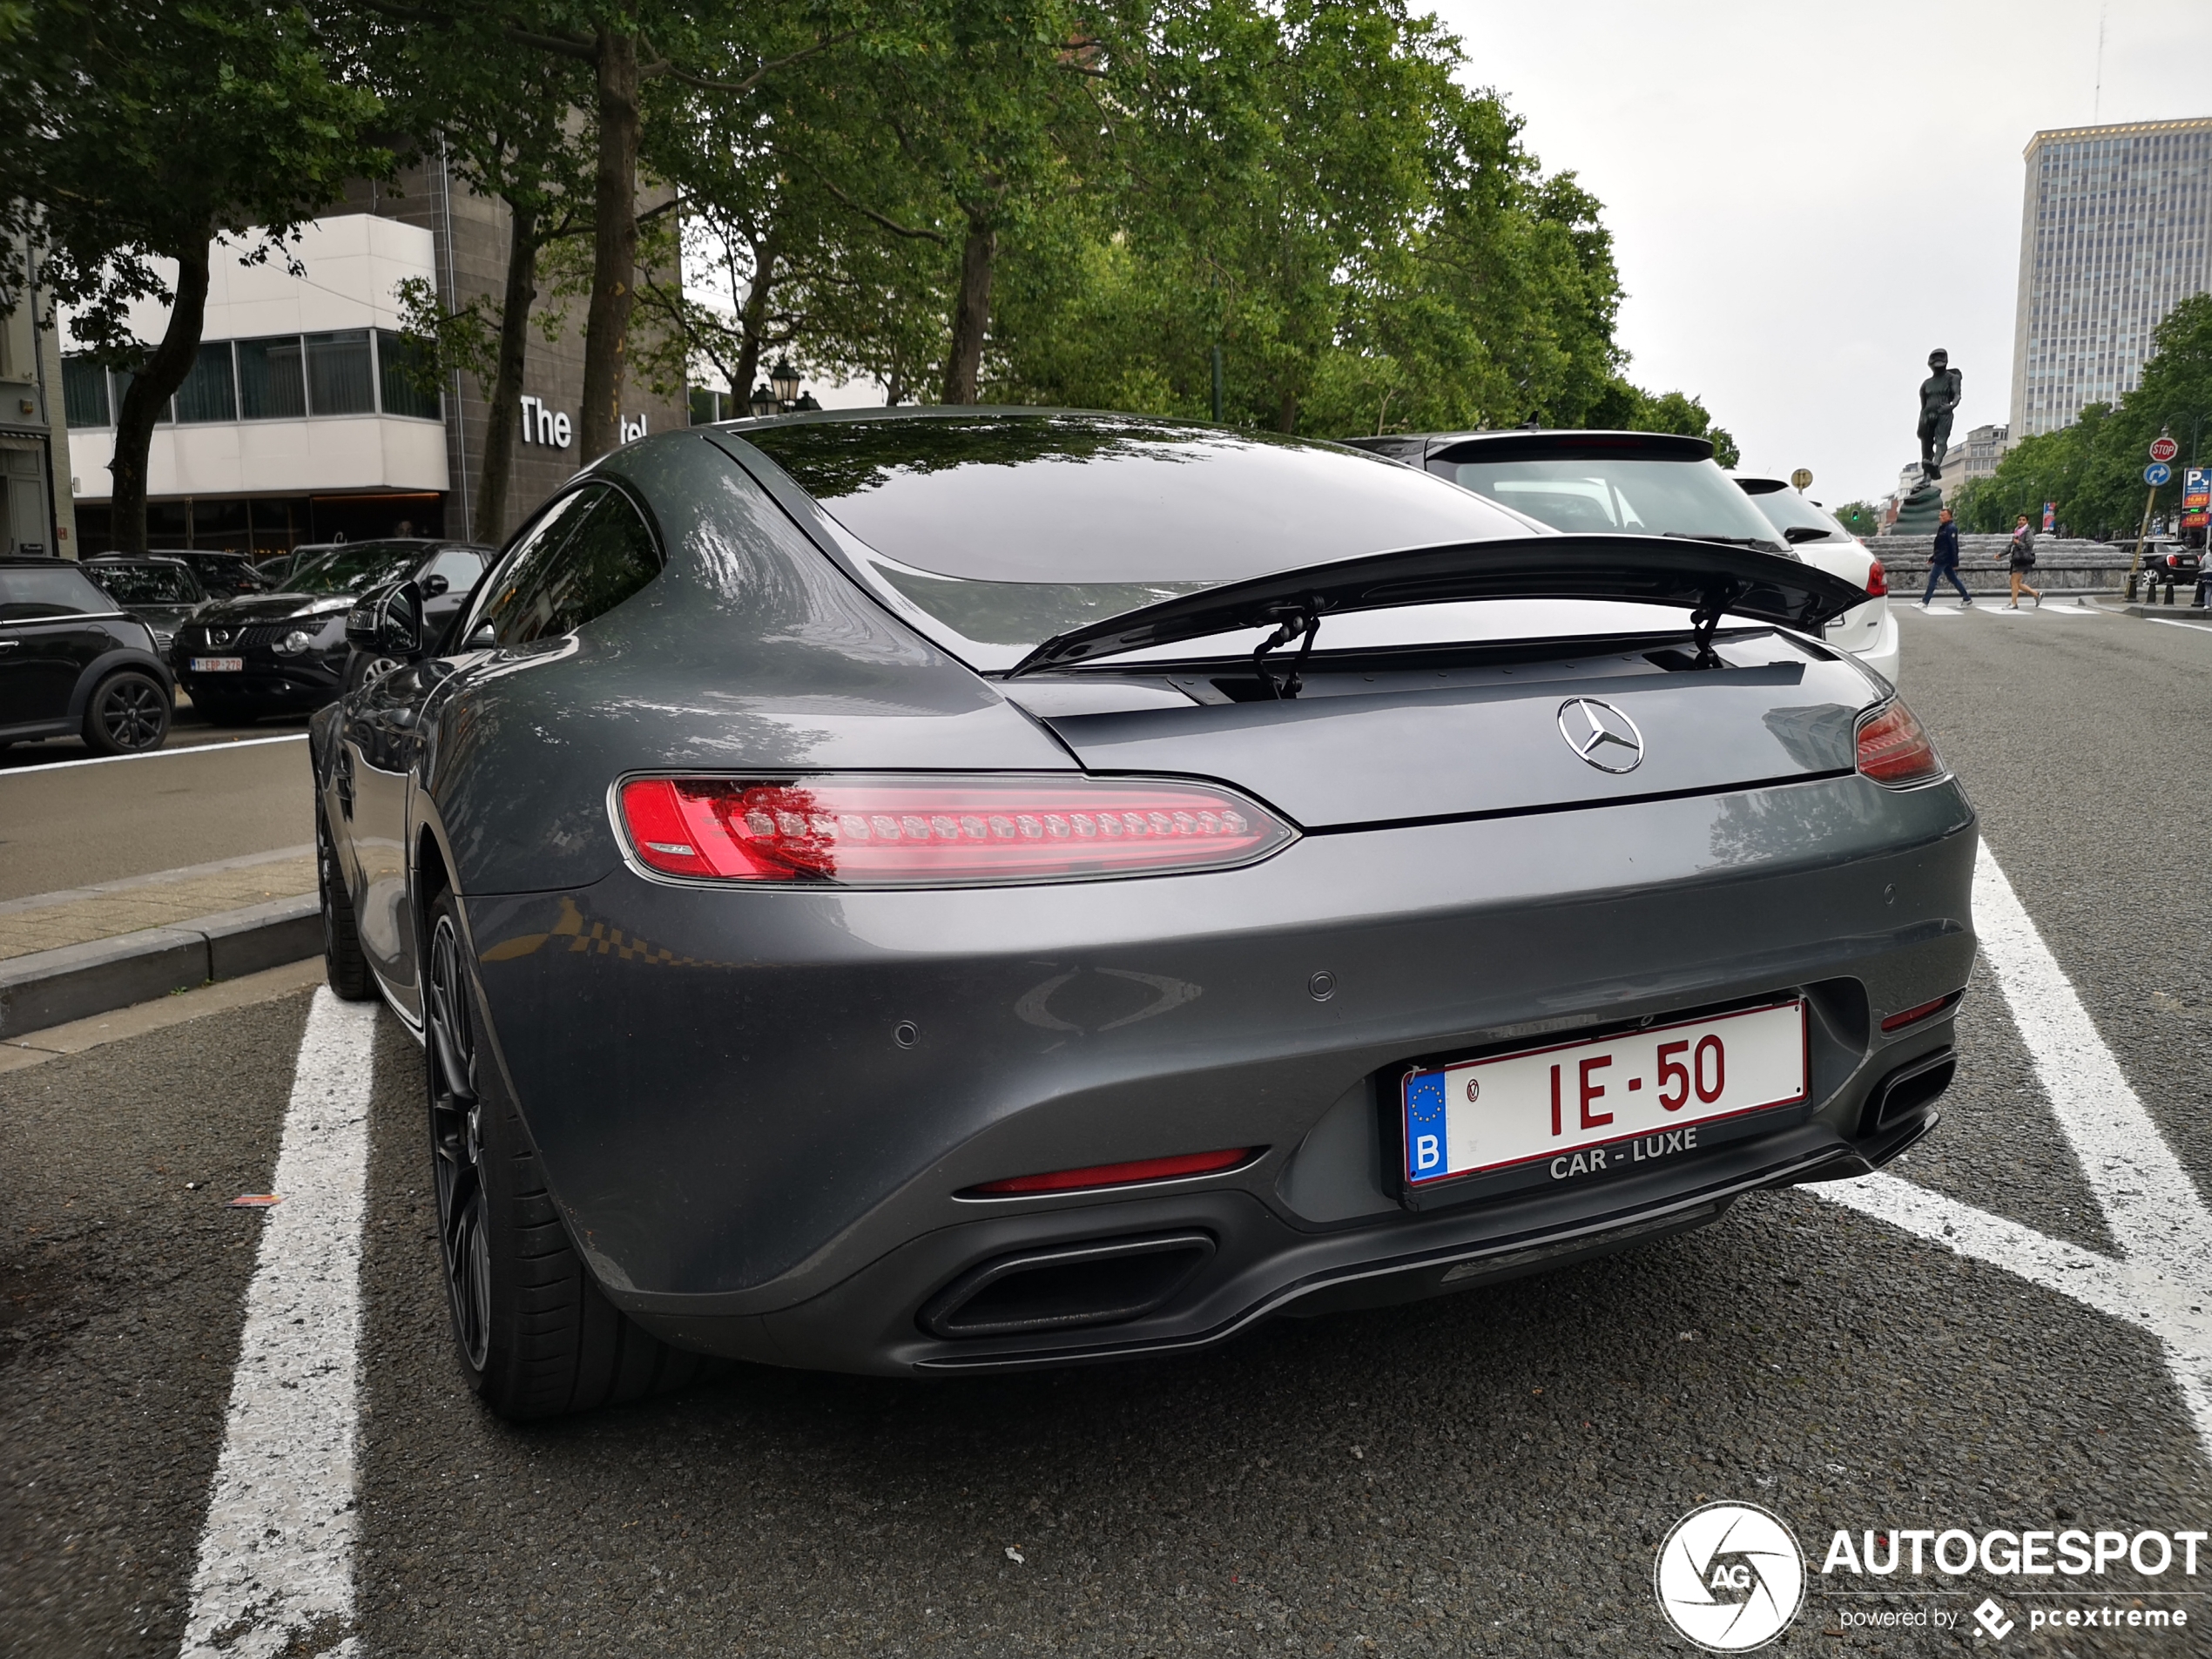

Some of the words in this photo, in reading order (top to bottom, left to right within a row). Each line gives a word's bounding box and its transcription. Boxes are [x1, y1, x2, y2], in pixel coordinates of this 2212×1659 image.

[521, 395, 571, 448] The
[620, 414, 647, 445] tel
[2153, 444, 2175, 455] STOP
[2188, 471, 2202, 486] P
[197, 659, 241, 671] 1-EBP-278
[1551, 1034, 1725, 1136] IE-50
[1417, 1135, 1440, 1170] B
[1550, 1149, 1607, 1179] CAR
[1633, 1127, 1697, 1162] LUXE
